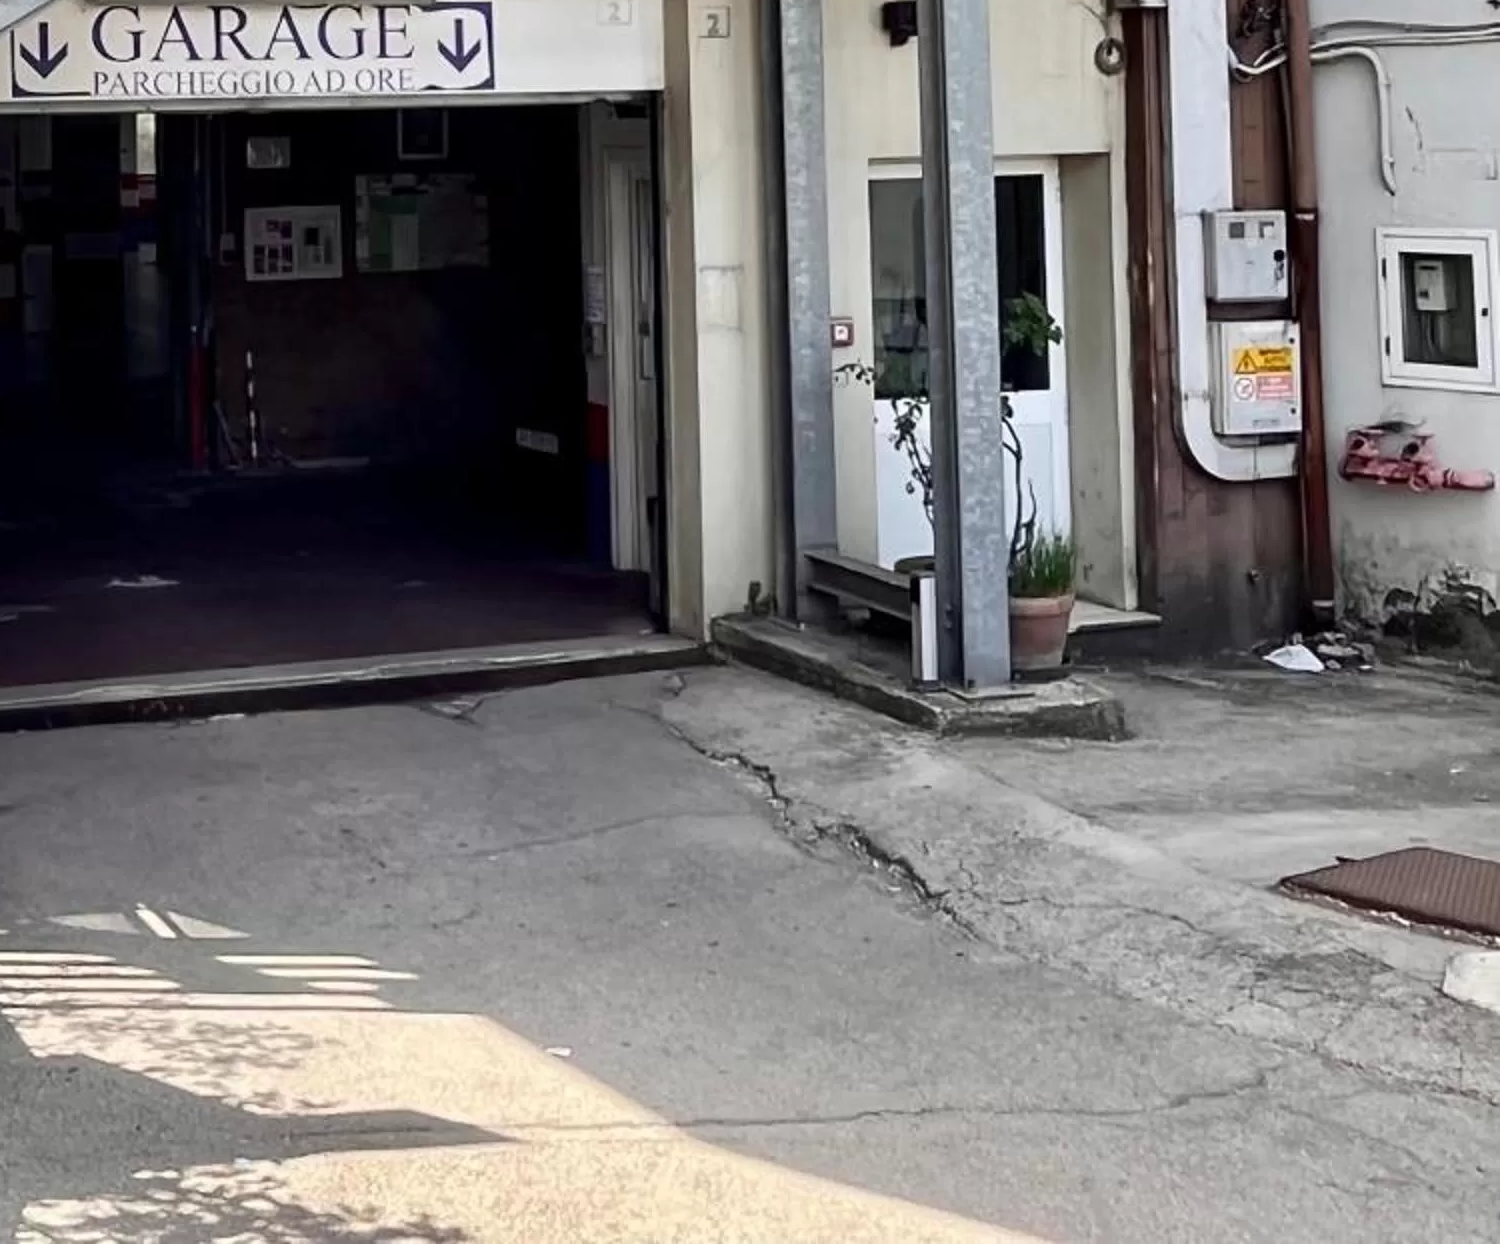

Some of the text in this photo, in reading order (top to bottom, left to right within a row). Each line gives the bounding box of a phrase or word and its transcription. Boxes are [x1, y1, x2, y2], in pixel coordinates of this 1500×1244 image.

[90, 5, 415, 62] GARAGE
[93, 68, 414, 96] PARCHEGGIO AD ORE
